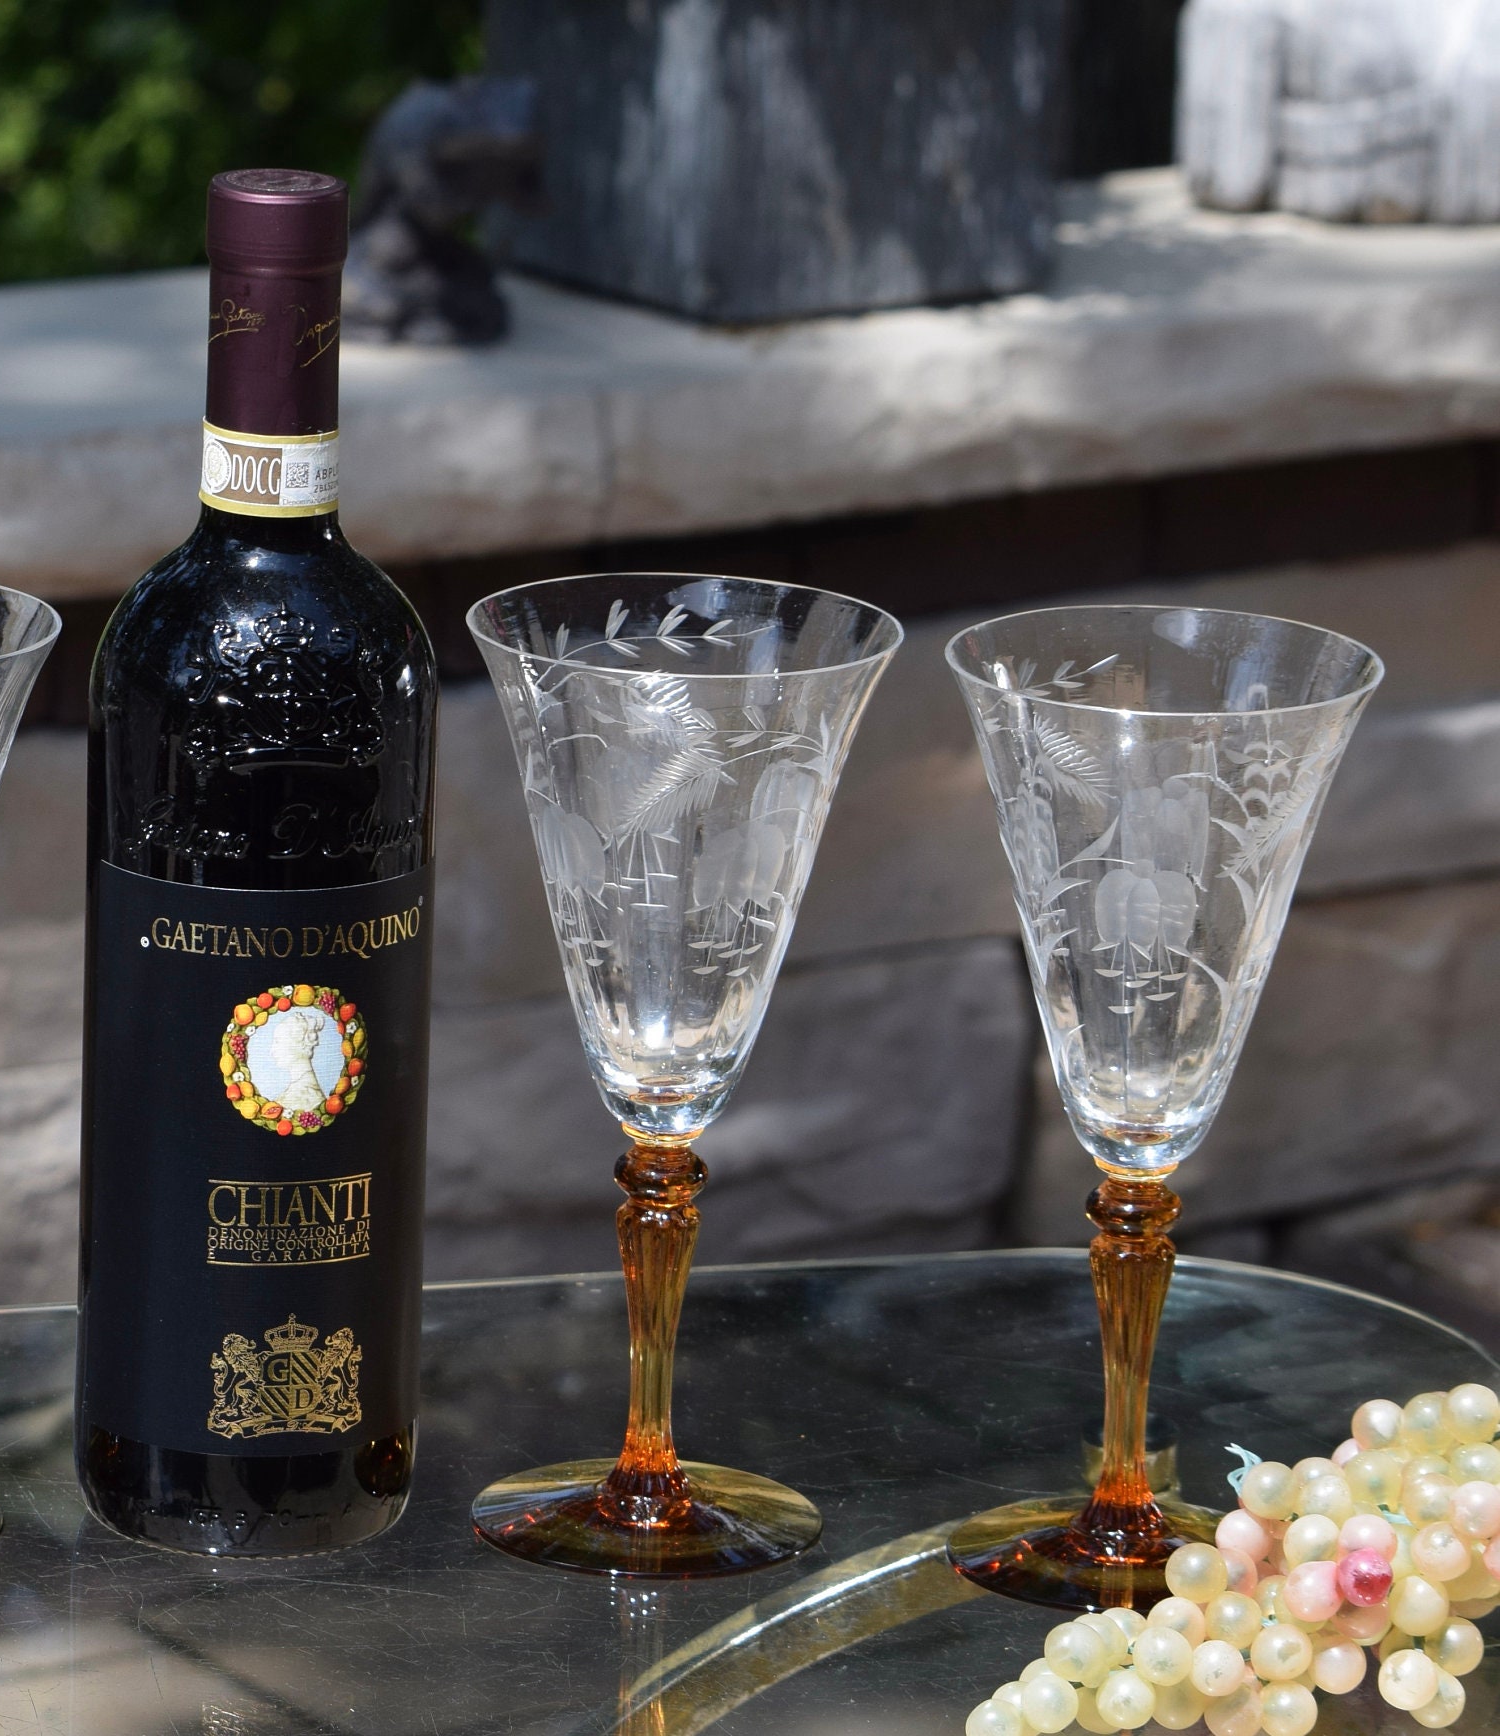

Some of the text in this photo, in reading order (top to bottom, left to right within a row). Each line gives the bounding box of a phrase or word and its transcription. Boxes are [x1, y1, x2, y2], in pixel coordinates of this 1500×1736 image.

[230, 453, 282, 495] DOCG
[151, 906, 421, 960] GAETANO D'AQUINO
[207, 1177, 373, 1228] CHIANTI
[207, 1230, 371, 1252] ORIGINE CONTROLLATA
[208, 1220, 371, 1241] DENOMINAZIONE DI
[207, 1243, 370, 1262] E GARANTITA
